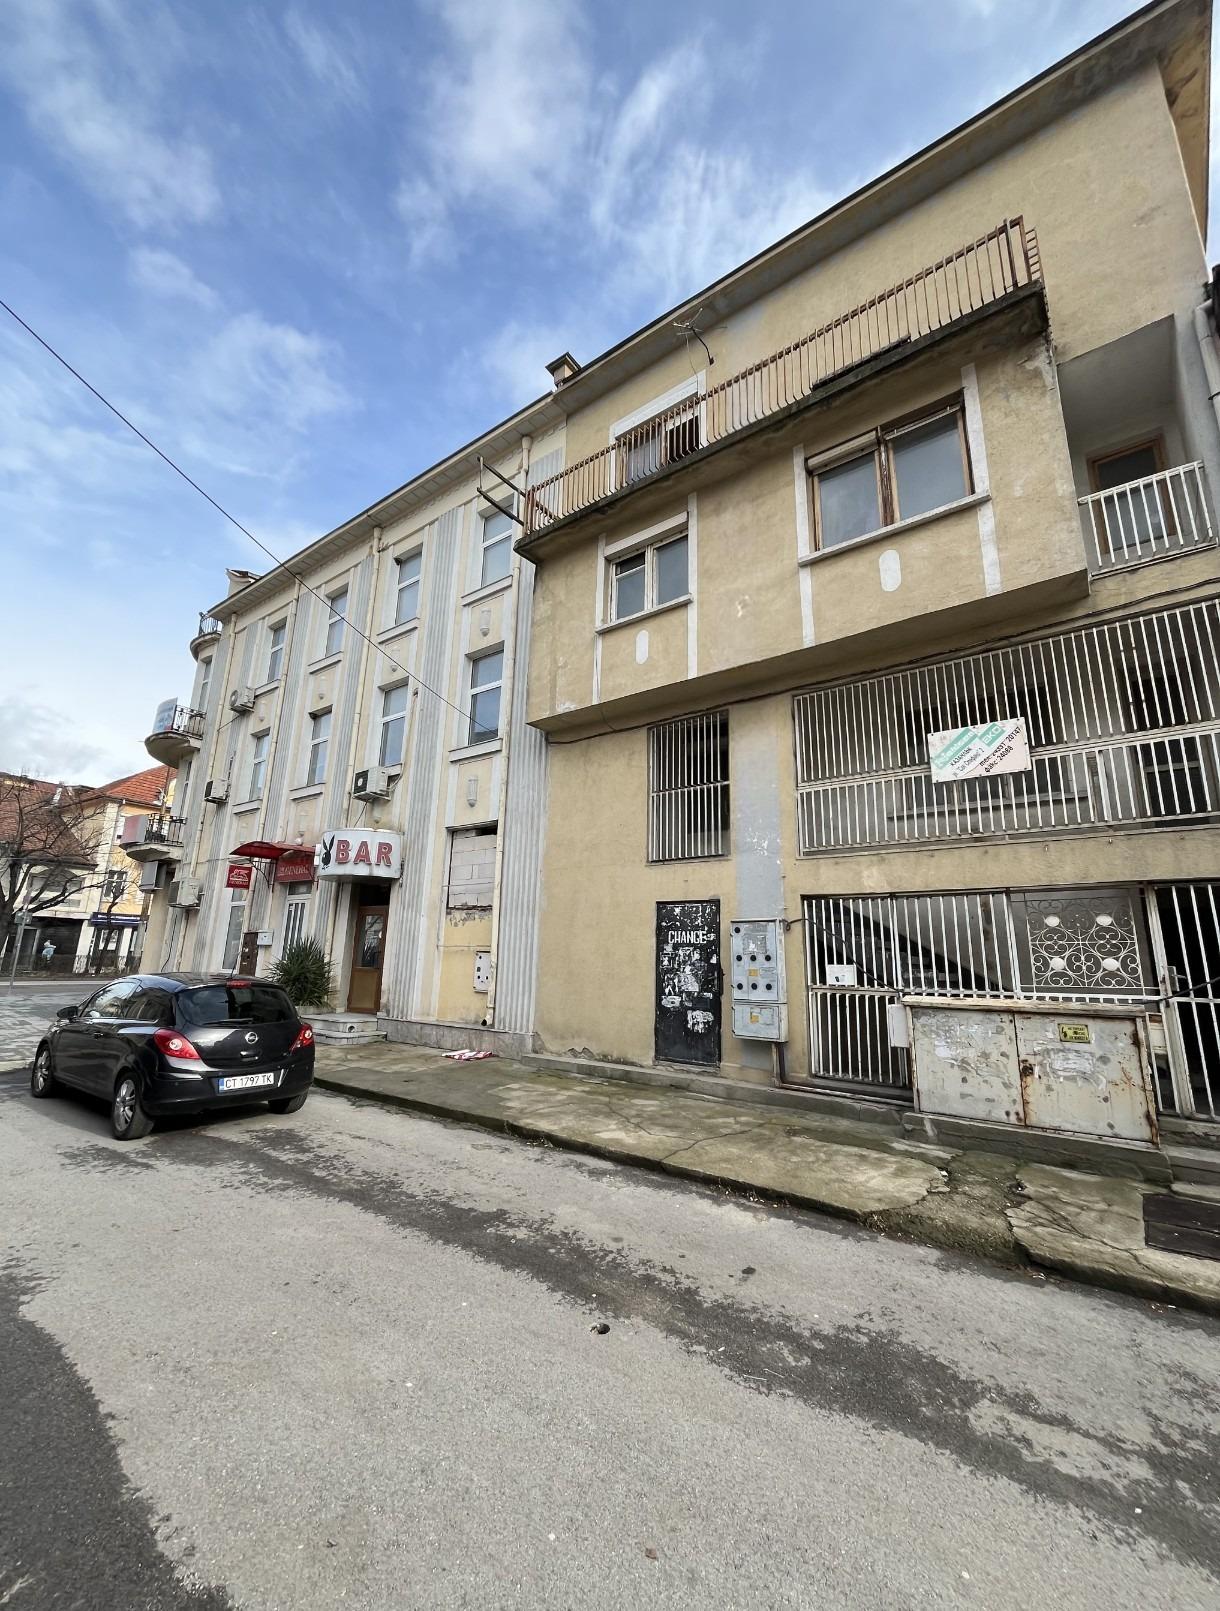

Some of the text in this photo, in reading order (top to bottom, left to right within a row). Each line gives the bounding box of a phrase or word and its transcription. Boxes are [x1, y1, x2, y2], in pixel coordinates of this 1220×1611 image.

[983, 726, 1001, 744] EKO
[335, 839, 393, 866] BAR
[668, 930, 707, 944] CHANGE
[225, 1074, 272, 1089] CT 1797 TK
